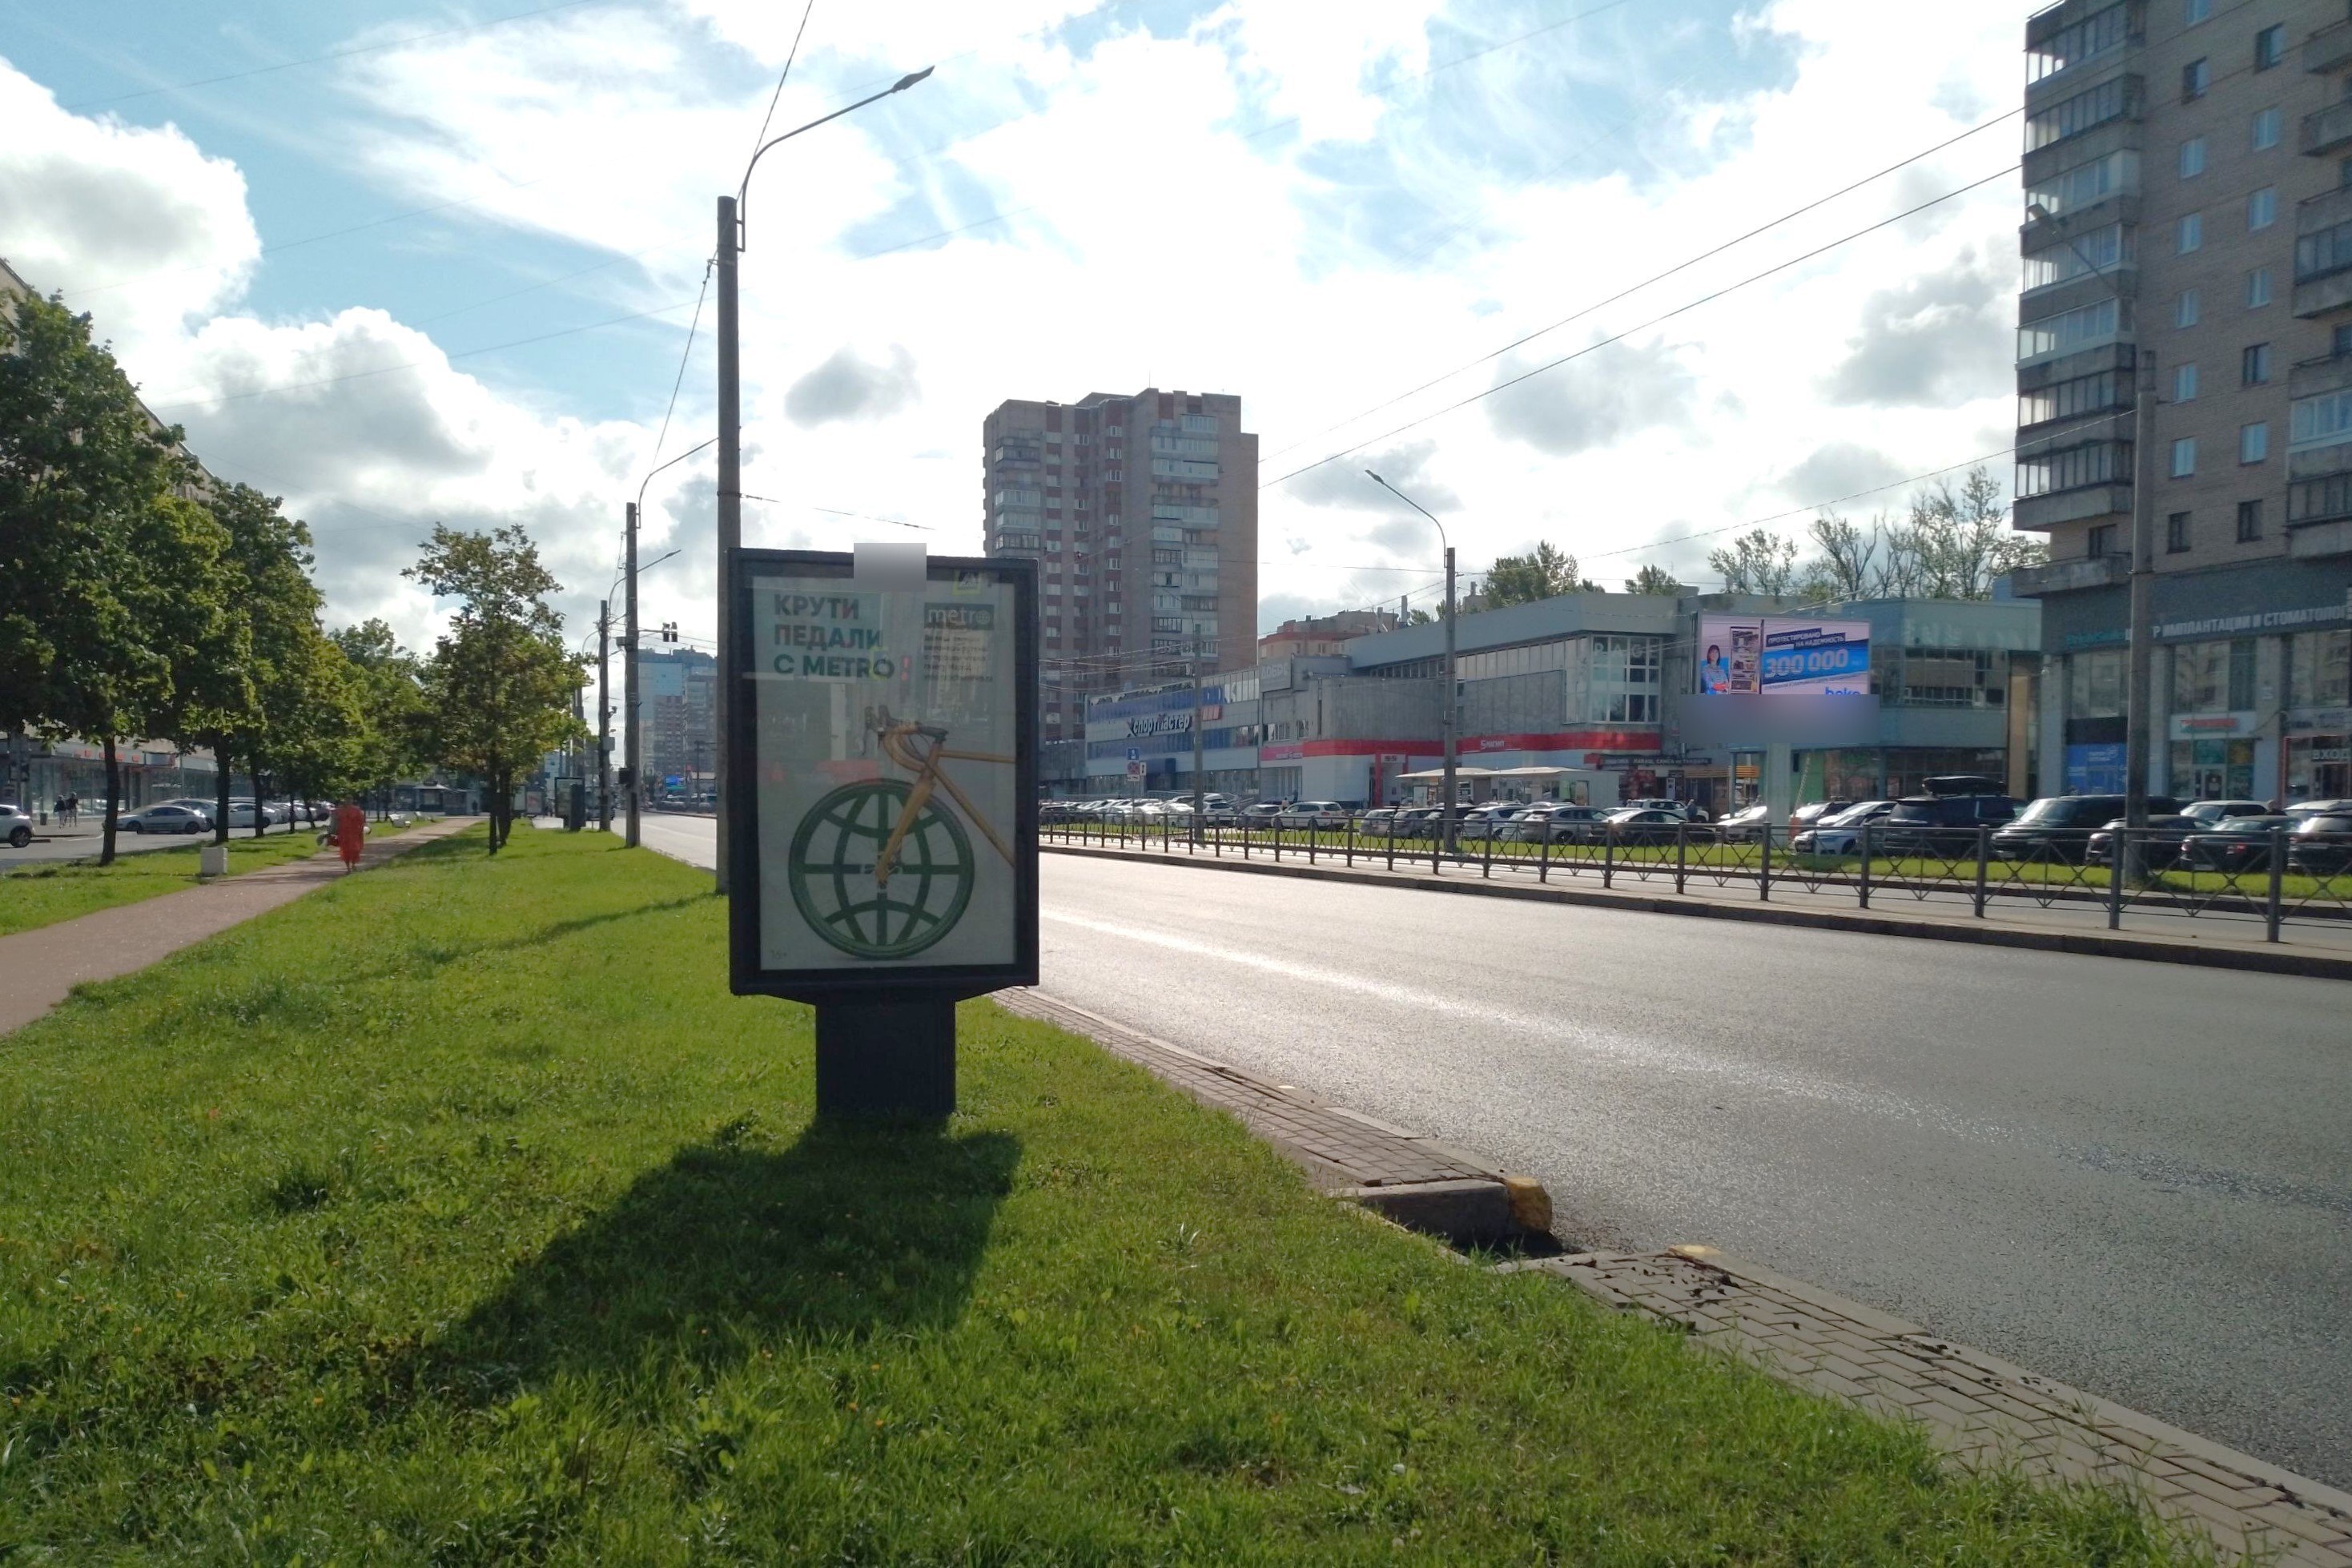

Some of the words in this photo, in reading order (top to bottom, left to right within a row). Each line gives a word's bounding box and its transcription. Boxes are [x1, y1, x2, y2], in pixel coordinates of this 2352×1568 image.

[774, 594, 859, 619] КРУТИ
[774, 624, 884, 651] ПЕДАЛИ
[802, 655, 895, 679] METRO
[1764, 654, 1804, 678] 300
[1807, 648, 1849, 671] 000
